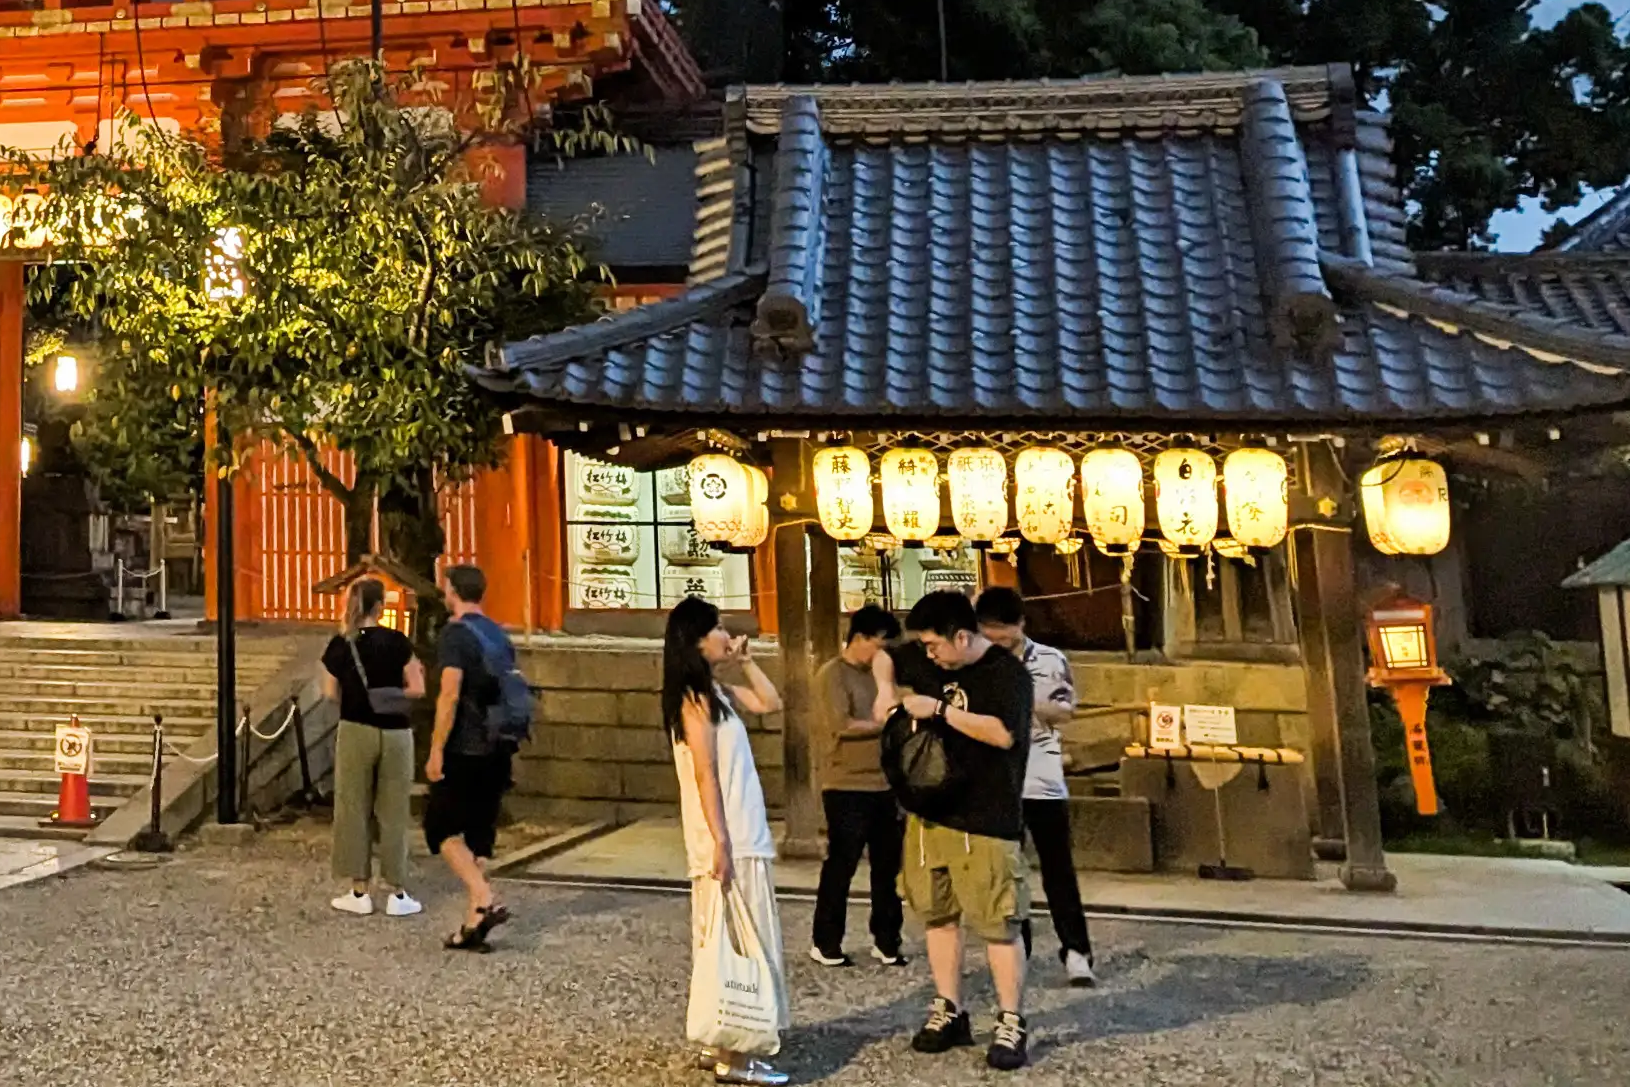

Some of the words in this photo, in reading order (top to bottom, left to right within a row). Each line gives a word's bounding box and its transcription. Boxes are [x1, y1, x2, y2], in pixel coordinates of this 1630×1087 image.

[586, 468, 628, 485] 松竹梅
[585, 526, 628, 544] 松竹梅
[584, 584, 627, 602] 松竹梅
